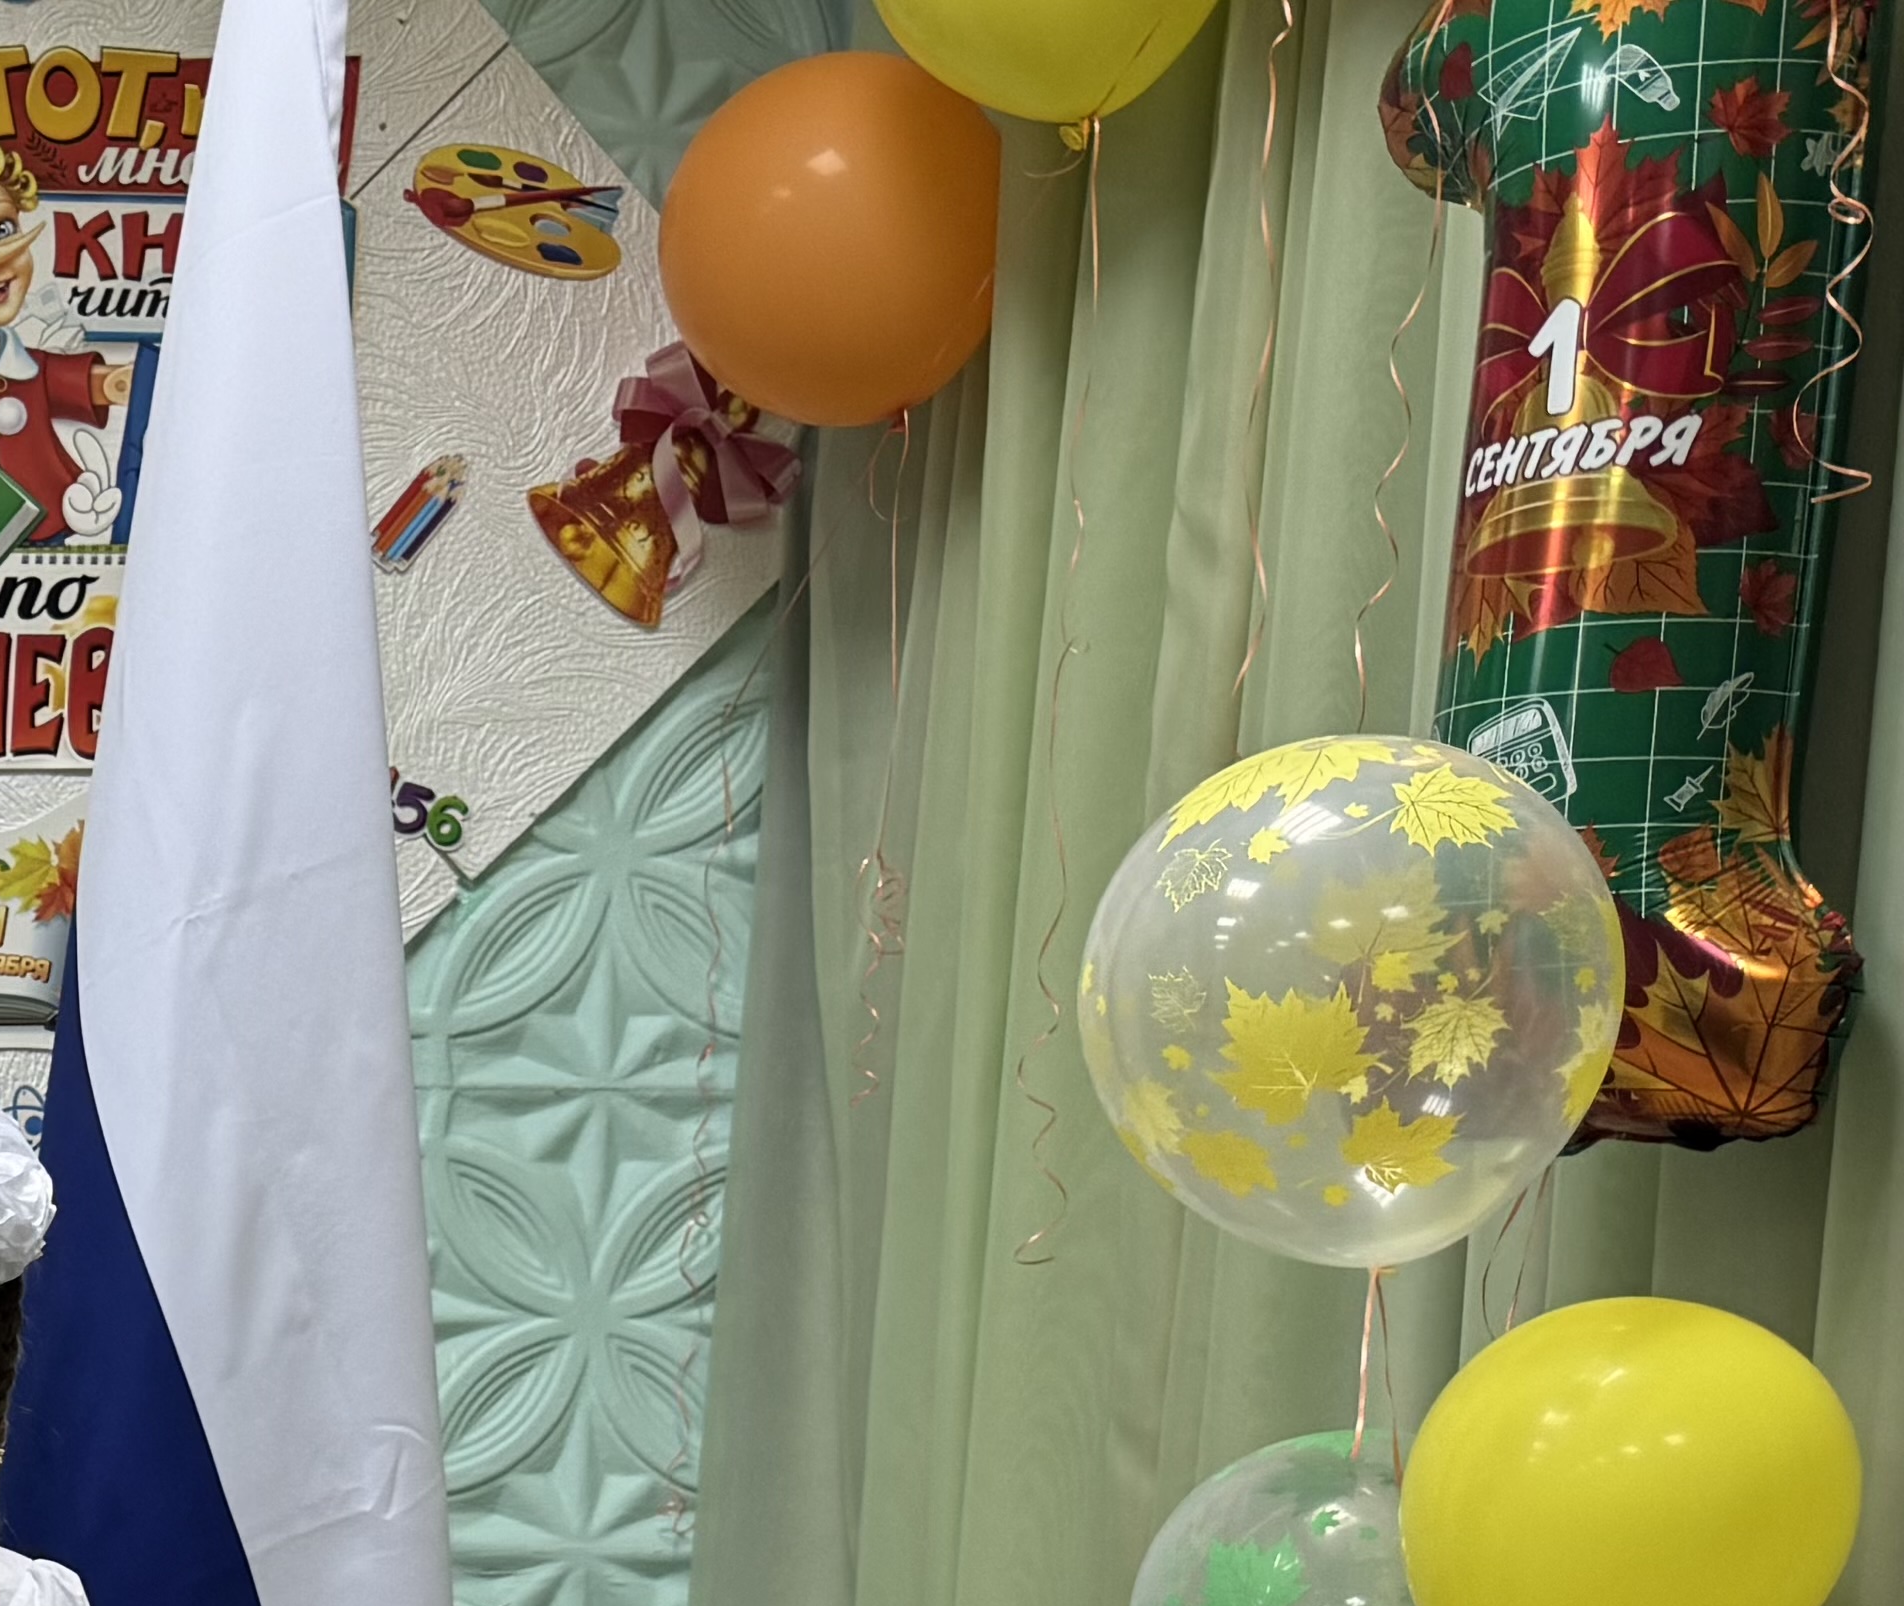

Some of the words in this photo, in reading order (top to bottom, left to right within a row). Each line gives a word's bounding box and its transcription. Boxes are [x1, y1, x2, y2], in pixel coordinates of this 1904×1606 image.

[78, 146, 196, 186] мно
[52, 209, 184, 282] КН
[68, 277, 172, 318] чит
[1527, 298, 1581, 415] 1
[1464, 413, 1703, 498] СЕНТЯБРЯ
